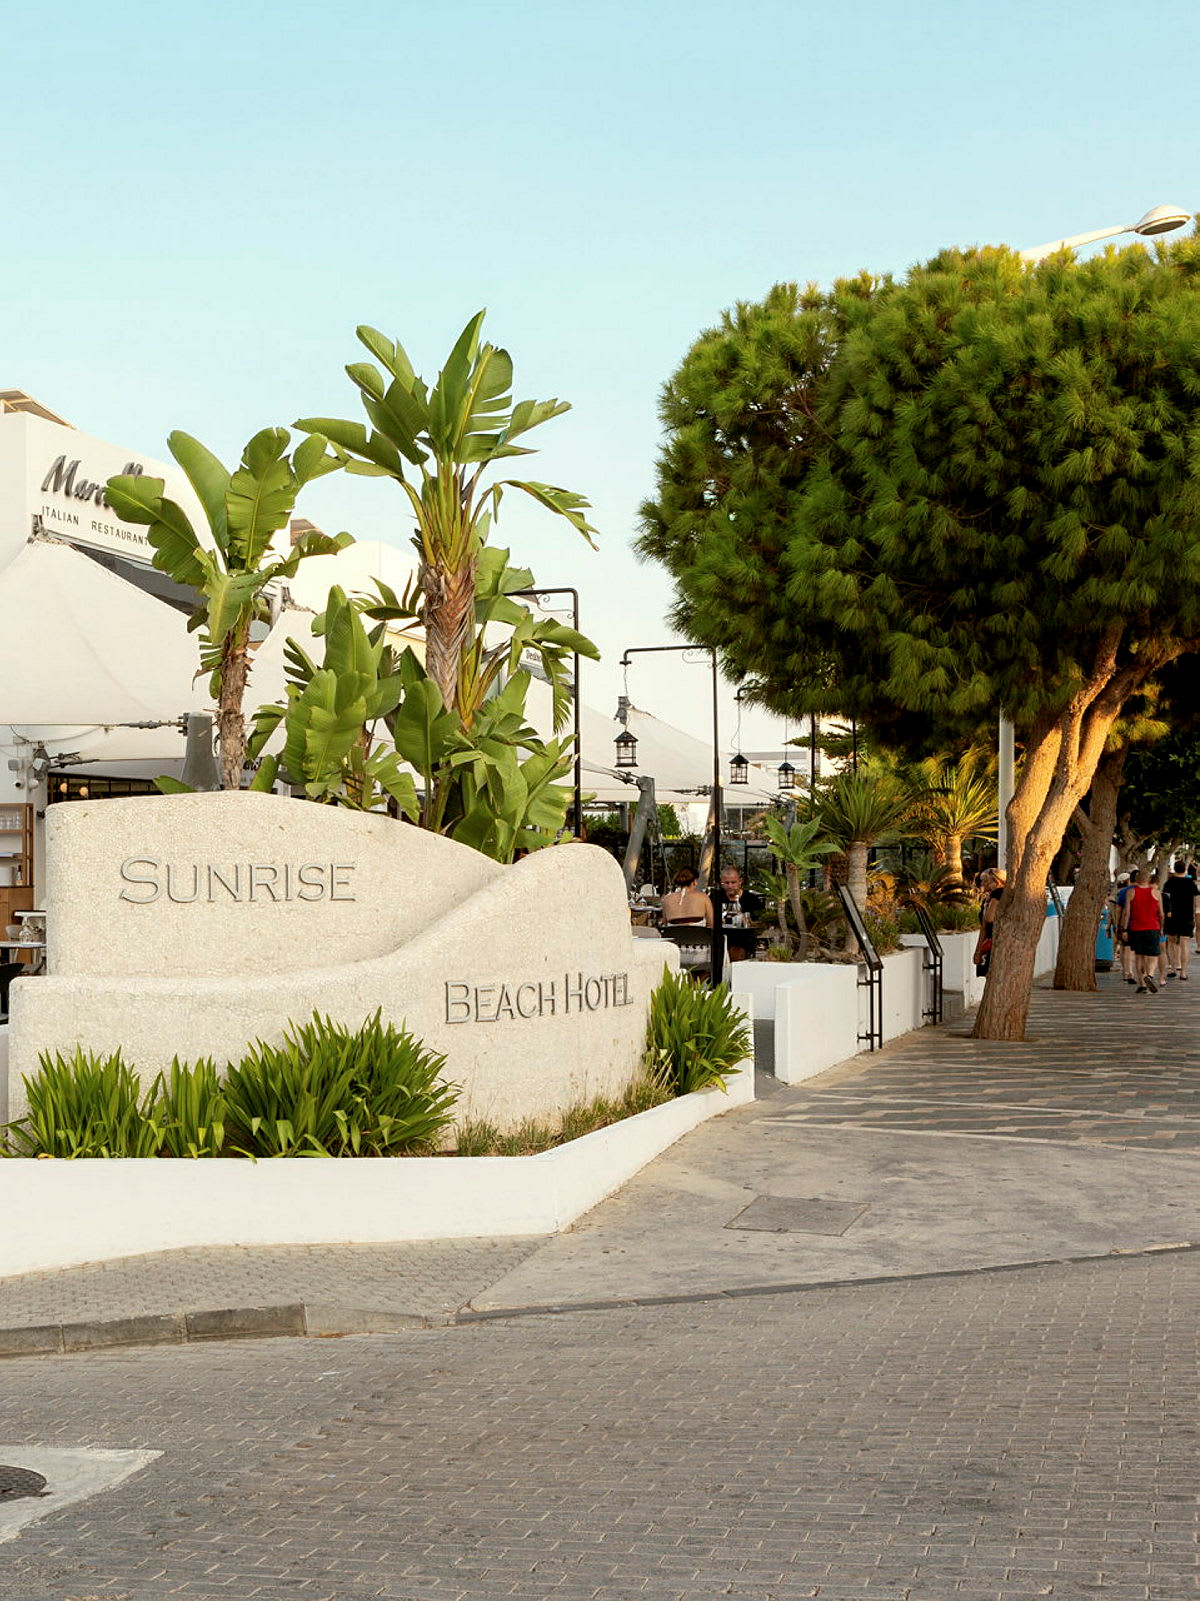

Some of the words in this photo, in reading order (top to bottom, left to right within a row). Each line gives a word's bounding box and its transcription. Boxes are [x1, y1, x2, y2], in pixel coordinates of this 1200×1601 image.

[41, 505, 79, 525] ITALIAN
[119, 856, 356, 904] SUNRISE
[444, 980, 556, 1024] BEACH
[564, 972, 634, 1014] HOTEL
